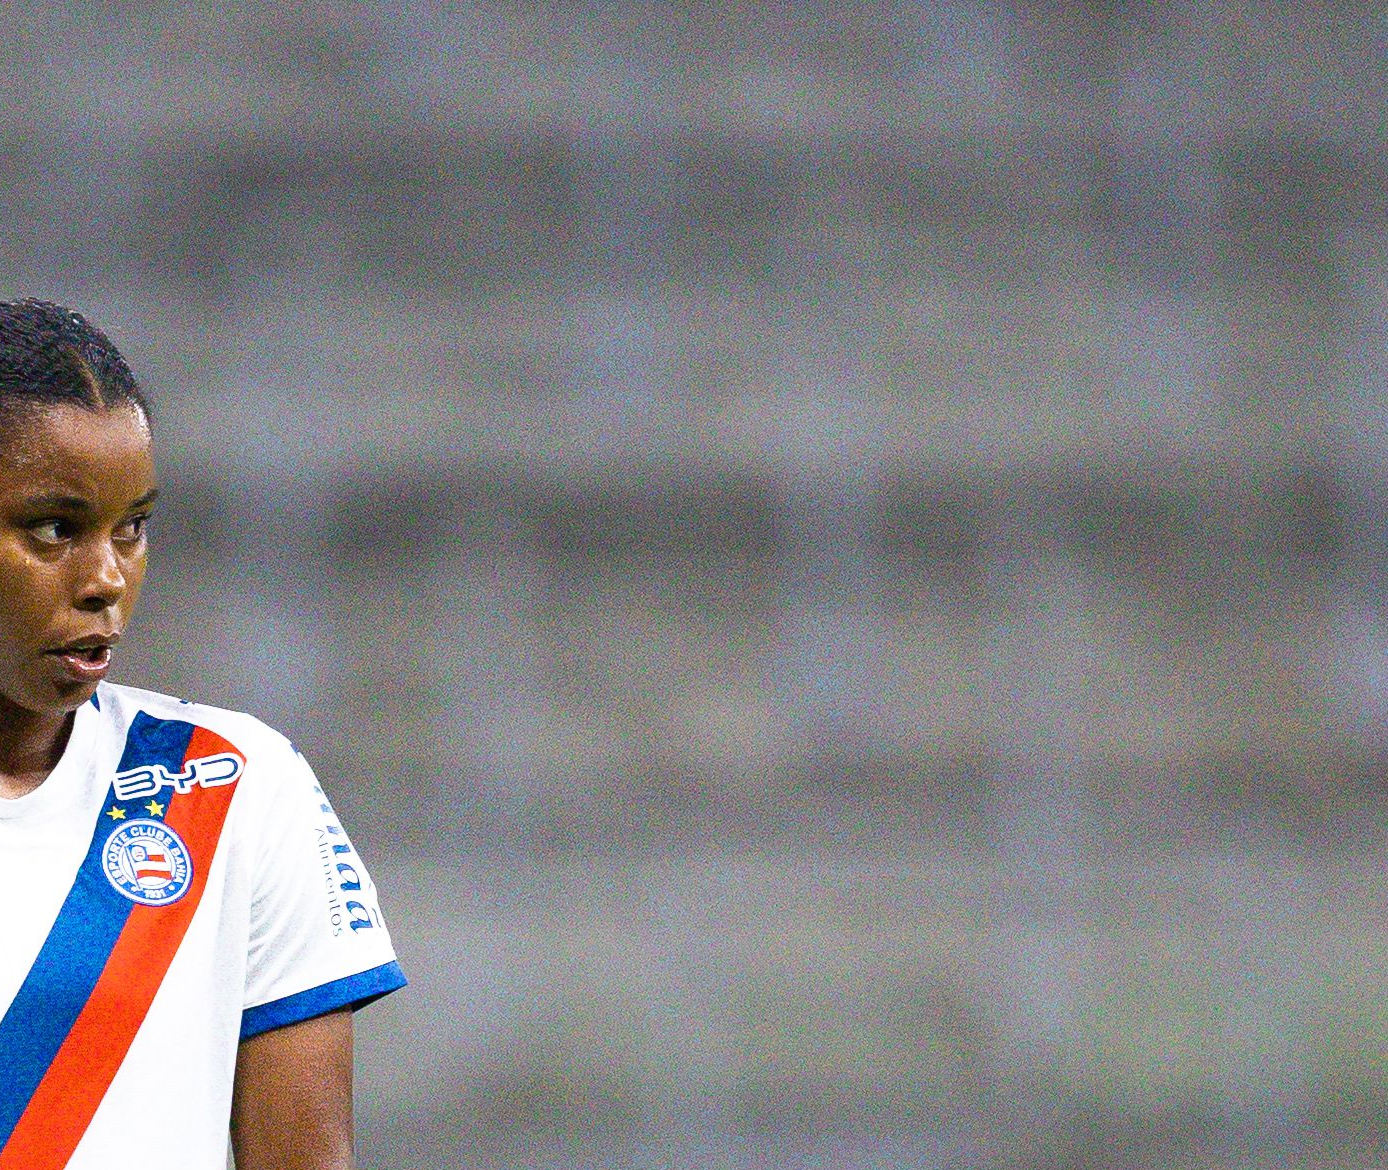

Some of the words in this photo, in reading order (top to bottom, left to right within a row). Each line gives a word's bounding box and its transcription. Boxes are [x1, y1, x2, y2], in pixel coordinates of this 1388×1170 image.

[116, 754, 242, 798] BYD
[108, 831, 130, 886] ESPORTE
[130, 825, 173, 847] CLUBE
[170, 845, 187, 884] BAHIA
